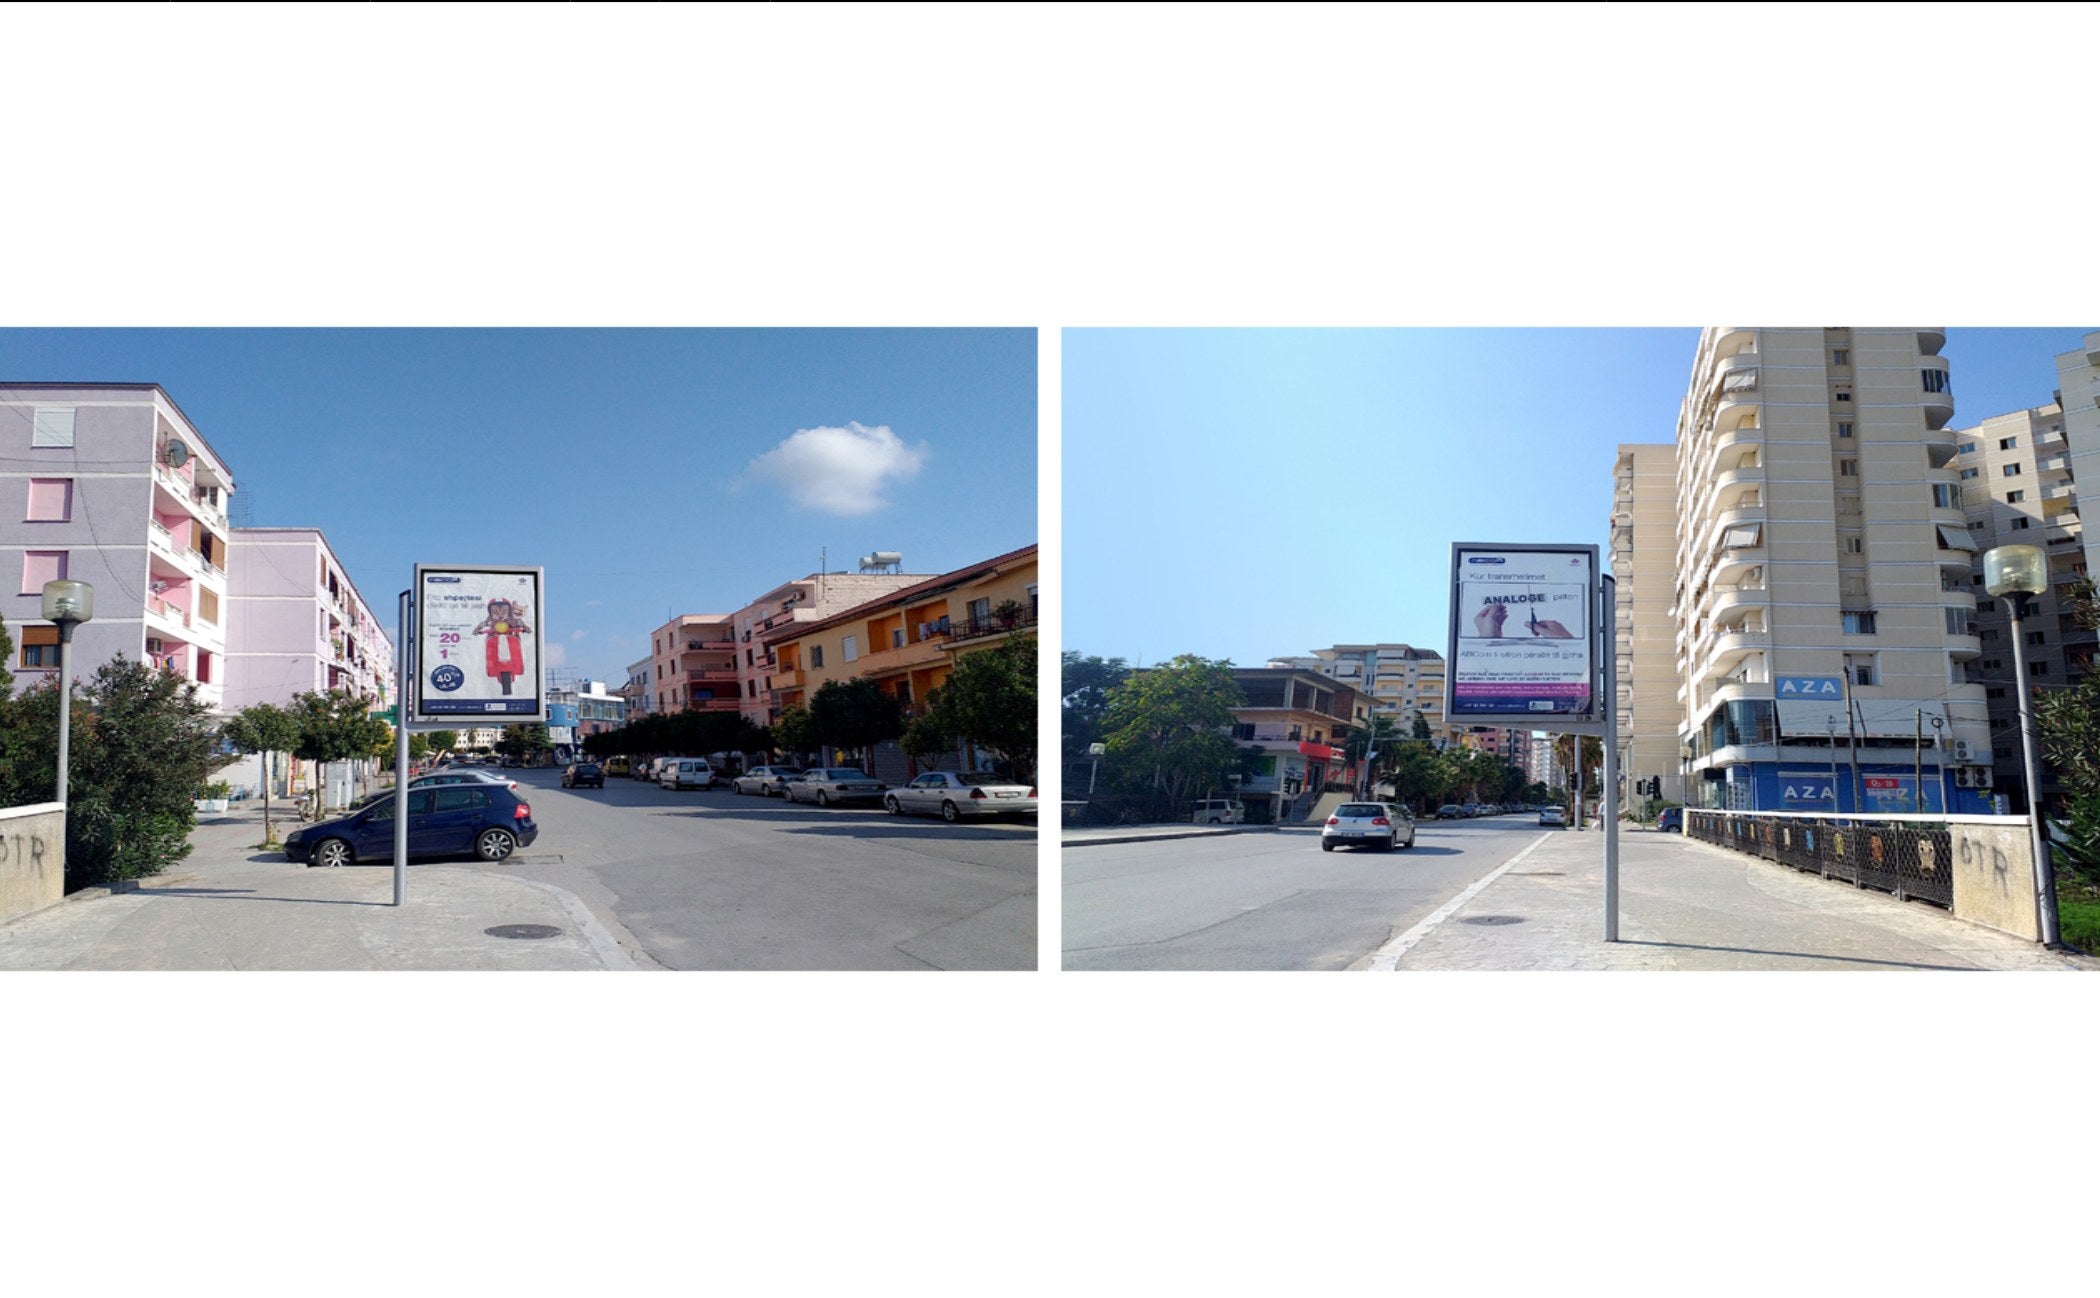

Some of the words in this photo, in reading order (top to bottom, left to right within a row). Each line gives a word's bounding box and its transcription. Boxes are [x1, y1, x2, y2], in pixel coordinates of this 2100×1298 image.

[1484, 593, 1546, 605] ANALOGE
[439, 632, 461, 643] 20
[440, 648, 448, 659] 1
[1782, 680, 1836, 693] AZA
[1784, 786, 1834, 799] AZA
